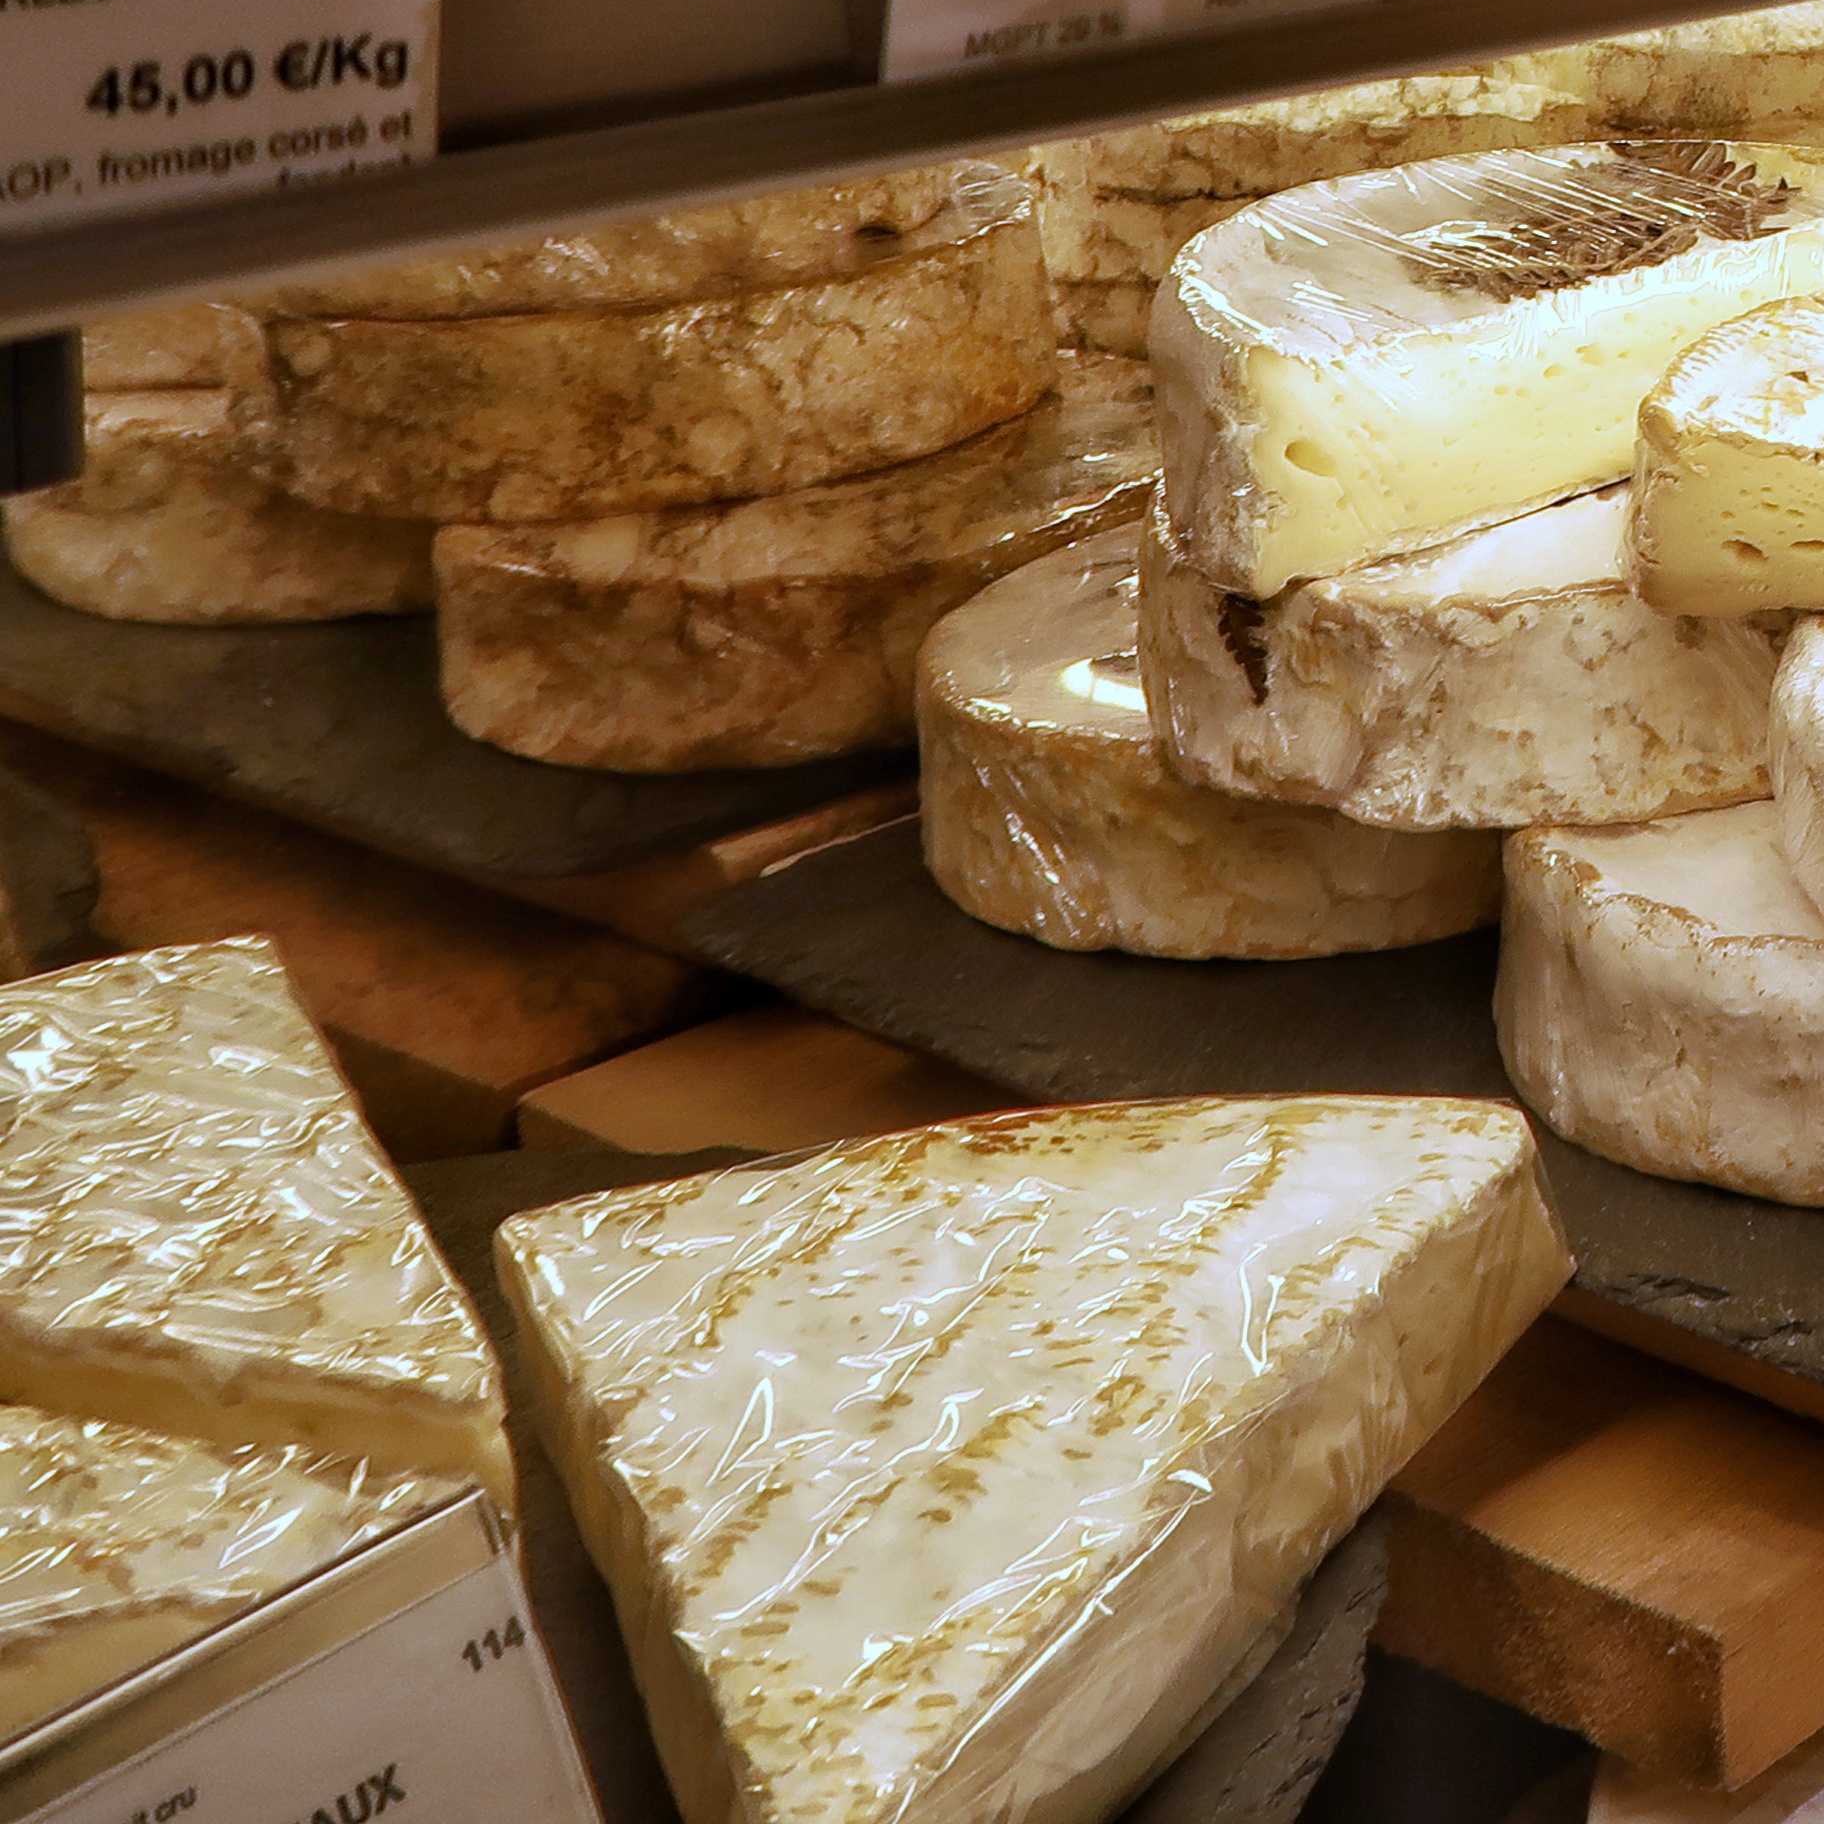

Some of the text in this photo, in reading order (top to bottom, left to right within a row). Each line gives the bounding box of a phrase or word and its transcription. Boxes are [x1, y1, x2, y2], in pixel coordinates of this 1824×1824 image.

[86, 32, 410, 118] 45,00 €/Kg
[97, 131, 257, 187] fromage
[267, 113, 369, 159] corsé
[379, 109, 413, 145] et
[461, 1616, 526, 1675] 114
[153, 1784, 198, 1824] cru
